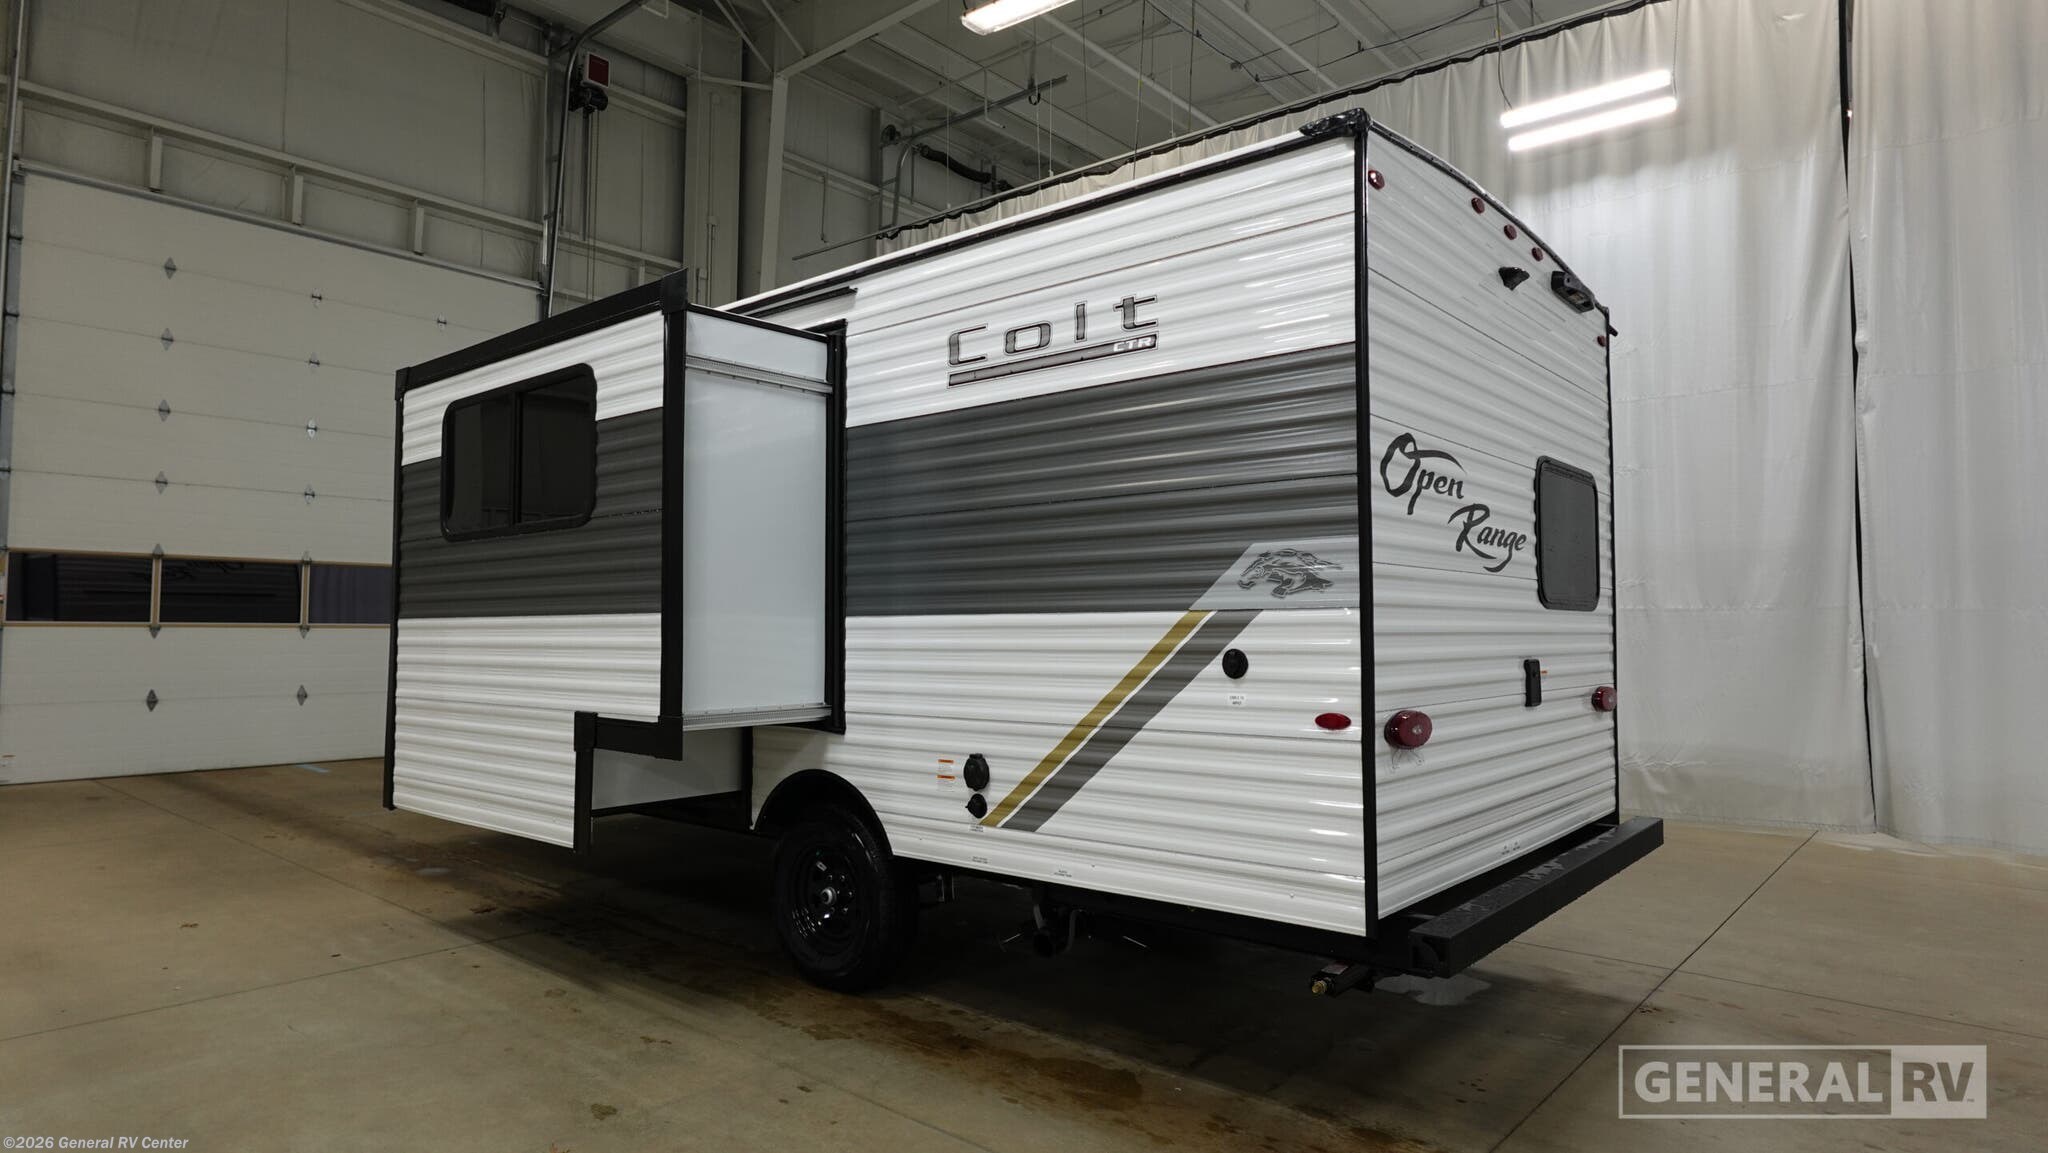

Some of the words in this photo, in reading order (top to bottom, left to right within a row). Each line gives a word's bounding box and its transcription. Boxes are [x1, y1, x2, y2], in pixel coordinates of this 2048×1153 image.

[948, 295, 1157, 366] Colt
[1113, 336, 1151, 352] CTR
[1380, 432, 1467, 515] Open
[1447, 503, 1527, 573] Range
